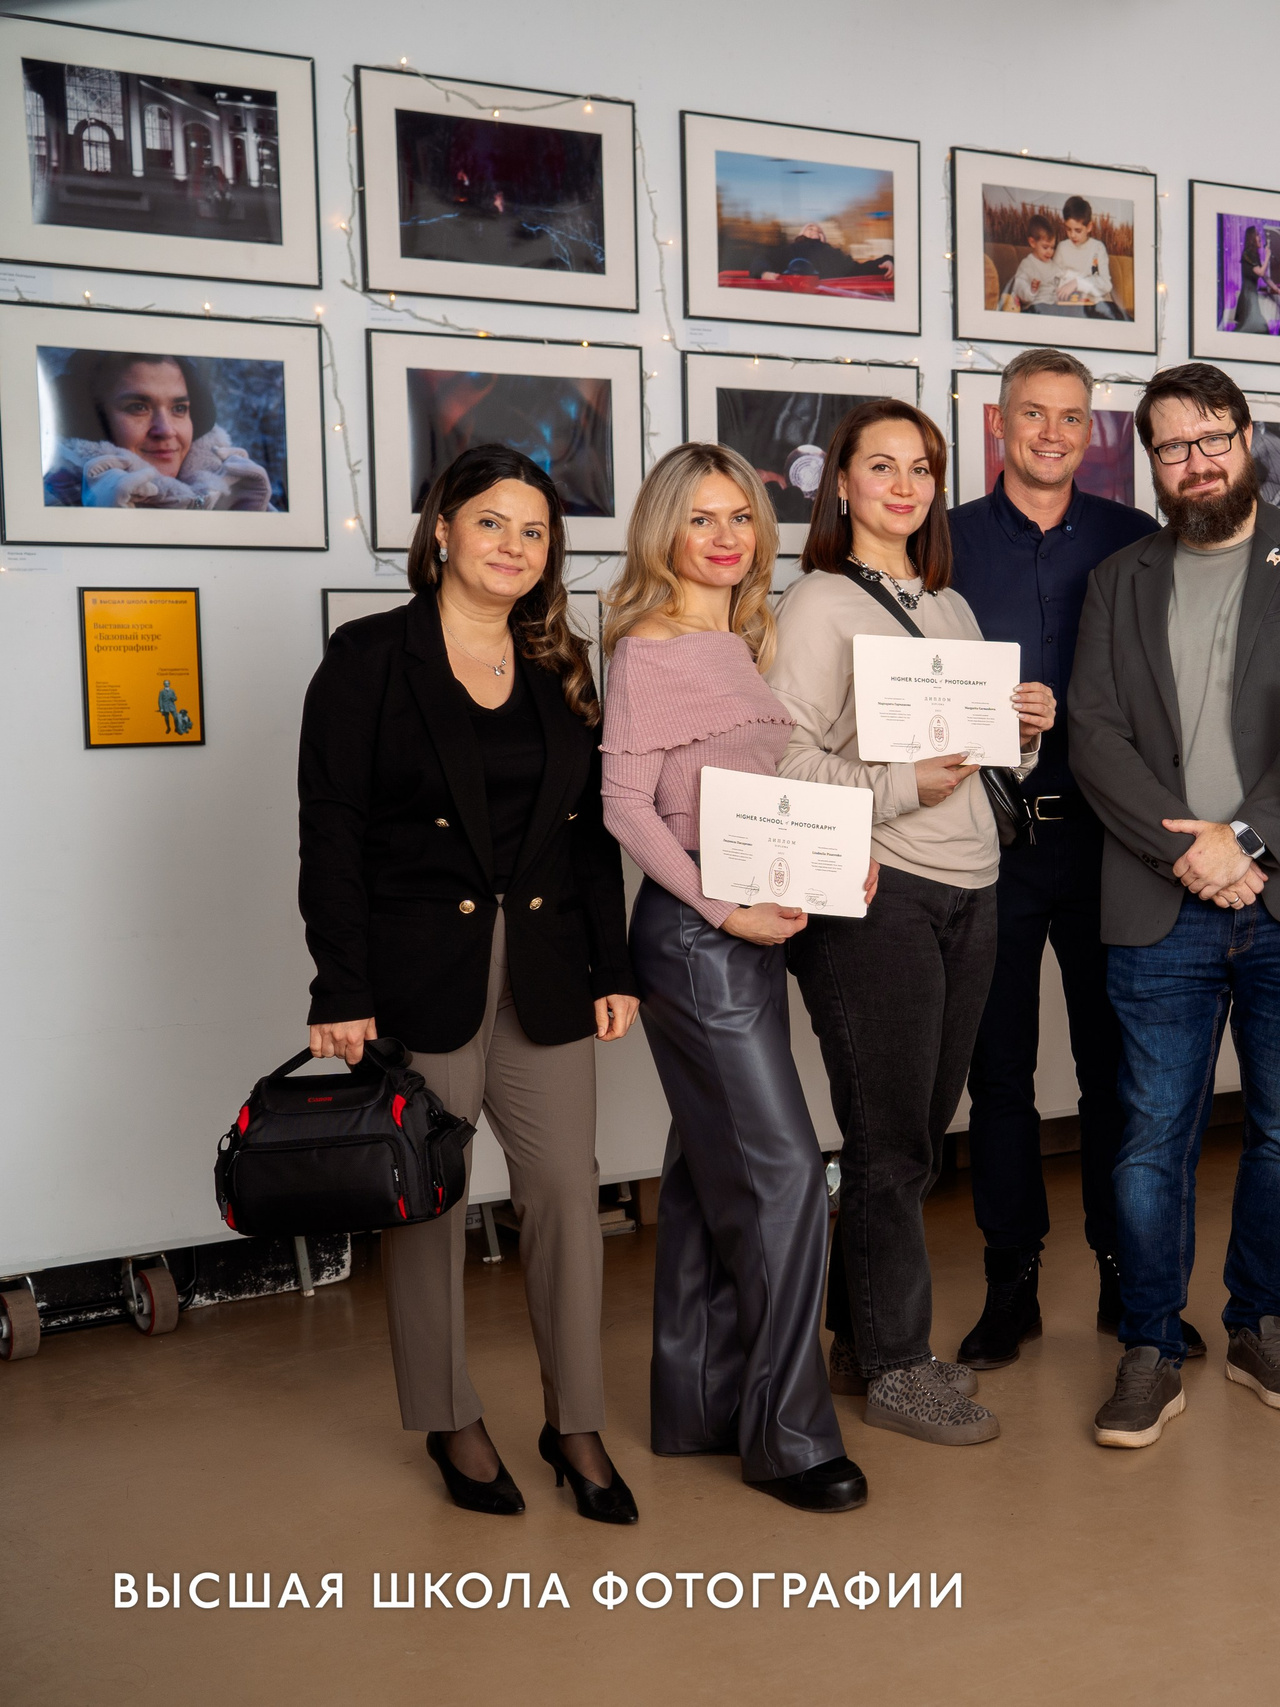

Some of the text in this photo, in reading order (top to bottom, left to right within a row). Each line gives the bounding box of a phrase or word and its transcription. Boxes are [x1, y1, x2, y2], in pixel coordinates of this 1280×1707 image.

[94, 632, 162, 642] «Базовый курс
[94, 644, 158, 653] фотографии»
[759, 817, 783, 825] SCHOOL
[791, 821, 836, 830] PHOTOGRAPHY
[768, 837, 796, 846] ДИПЛОМ
